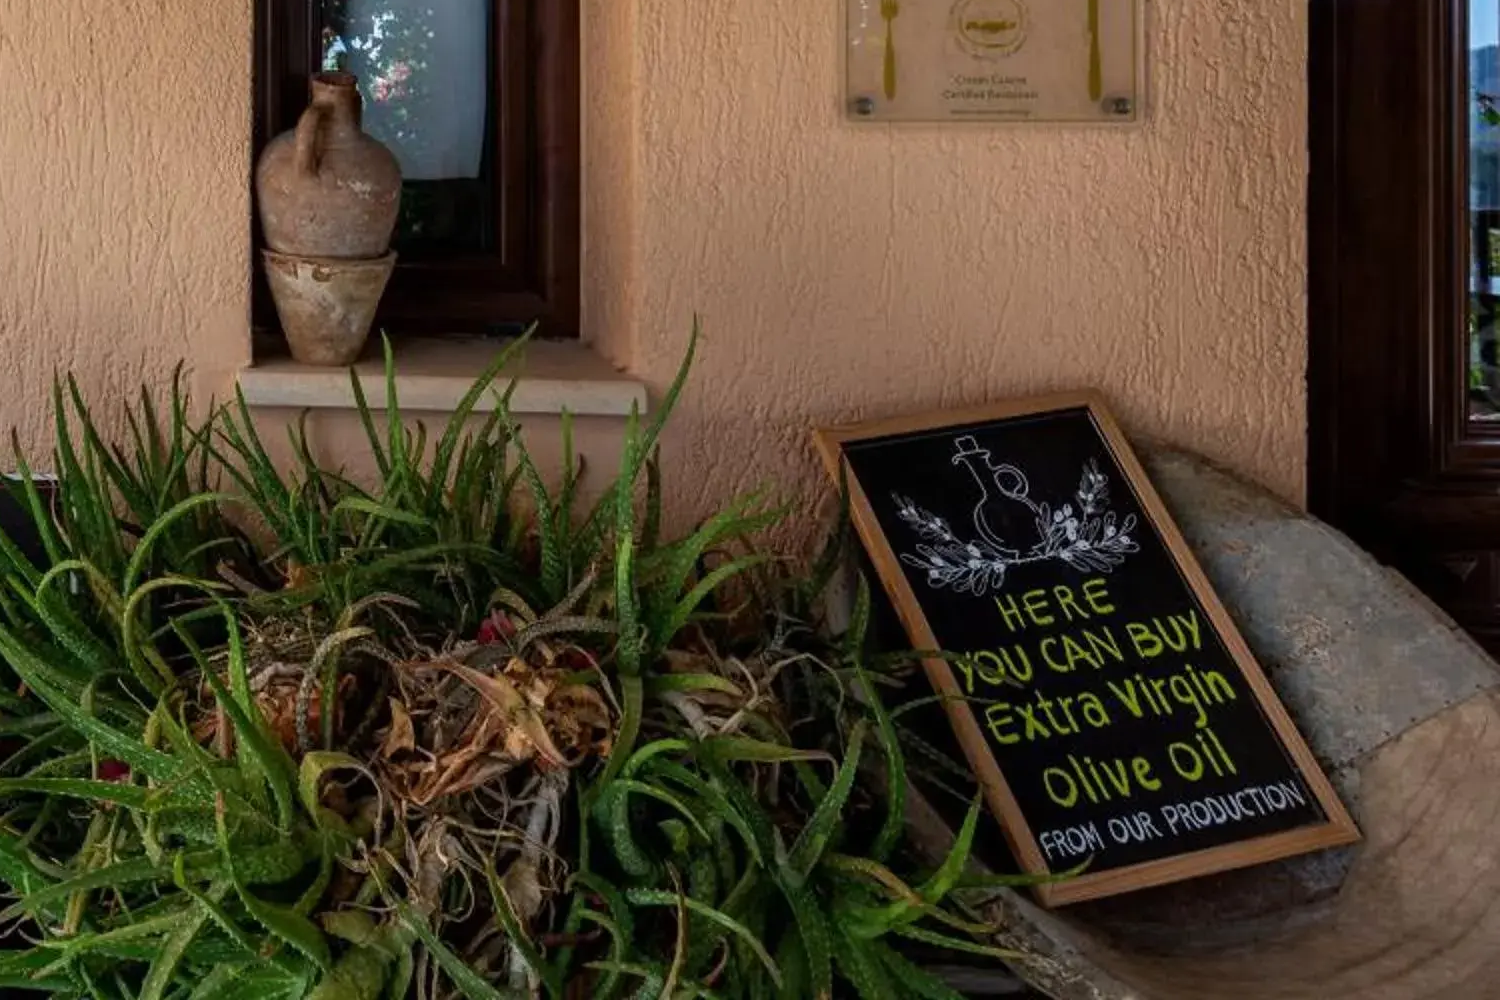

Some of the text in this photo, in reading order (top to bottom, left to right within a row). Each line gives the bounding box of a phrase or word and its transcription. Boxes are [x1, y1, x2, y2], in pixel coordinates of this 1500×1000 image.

[994, 578, 1116, 632] HERE
[954, 609, 1203, 693] YOU CAN BUY
[984, 664, 1238, 744] Extra Virgin
[1043, 726, 1238, 808] Olive Oil
[1039, 779, 1307, 863] FROM OUR PRODUCTION
